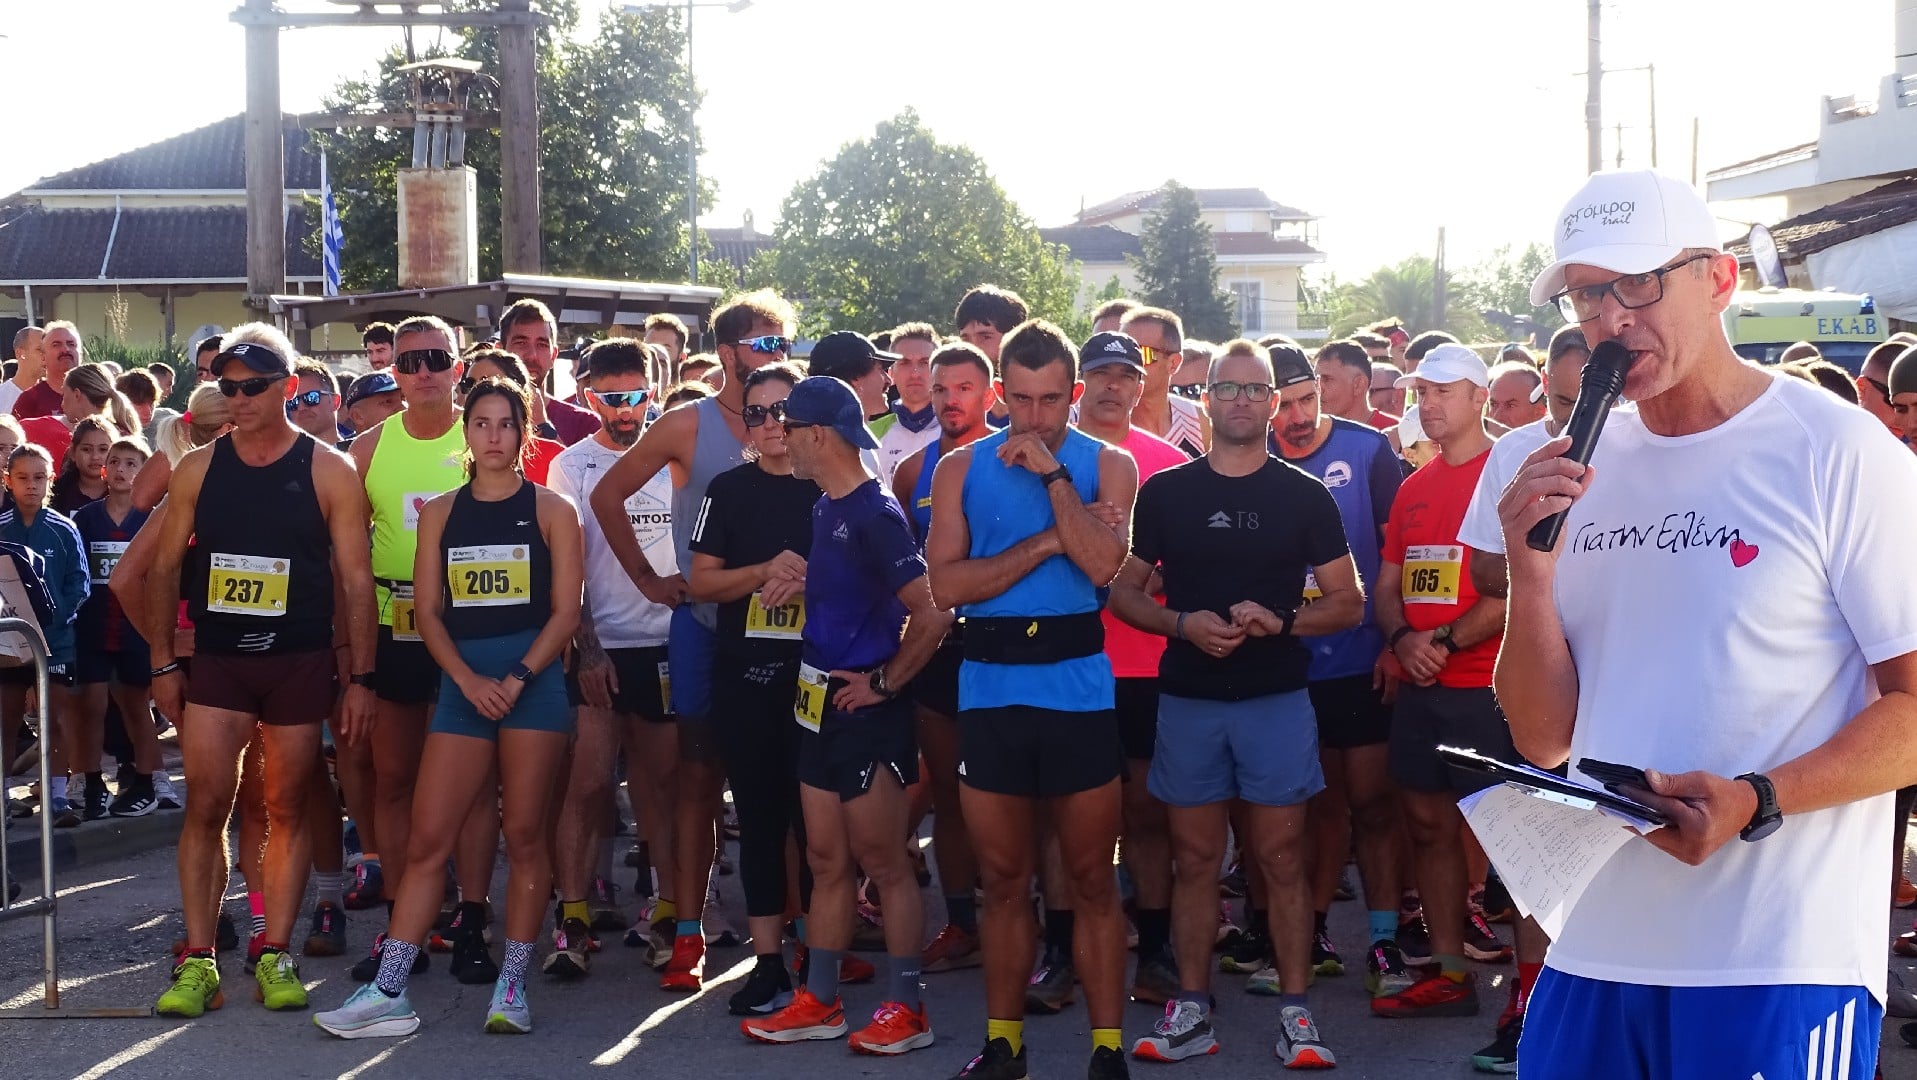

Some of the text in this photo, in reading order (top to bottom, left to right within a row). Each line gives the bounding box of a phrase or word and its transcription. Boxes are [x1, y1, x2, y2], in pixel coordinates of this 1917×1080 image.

[1601, 211, 1632, 225] trail
[629, 513, 671, 524] ΝΤΟΣ
[1236, 511, 1259, 529] T8
[1656, 511, 1740, 553] Ελένη
[224, 577, 264, 604] 237
[465, 569, 510, 595] 205
[1411, 568, 1440, 593] 165
[765, 604, 801, 628] 167
